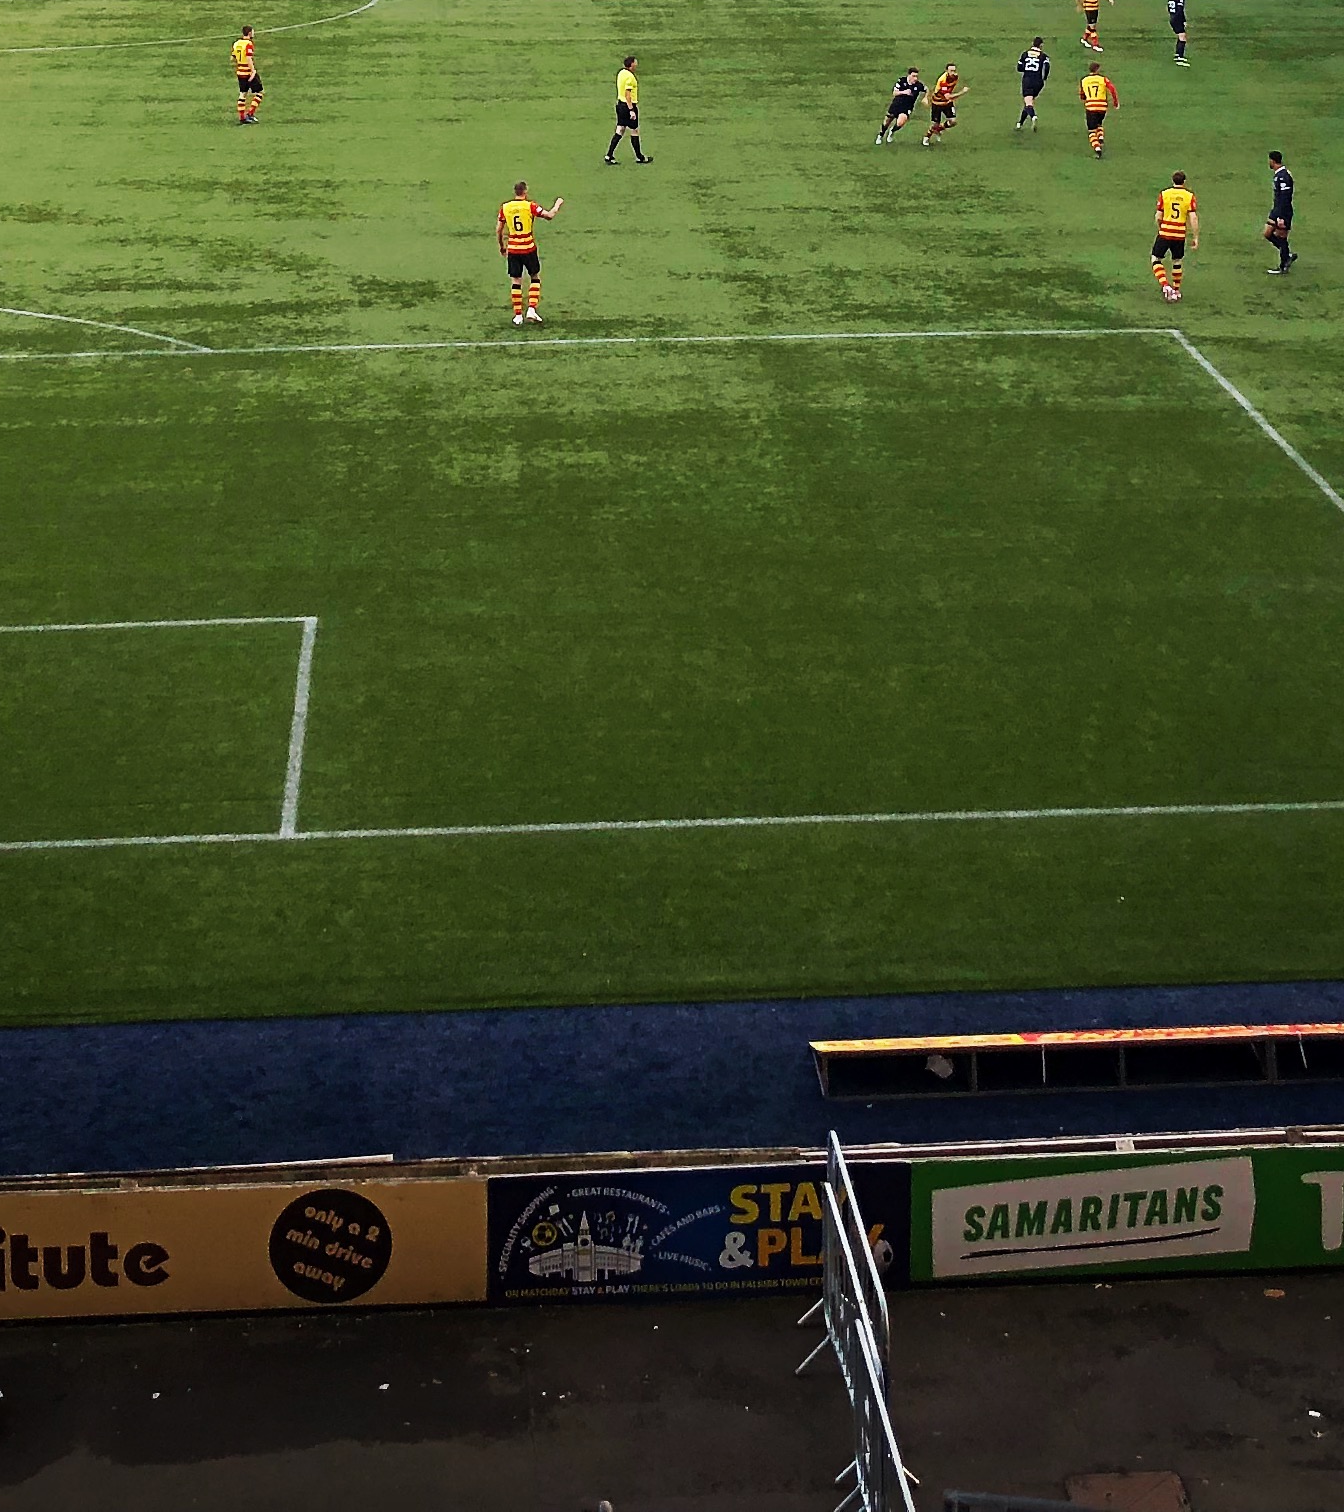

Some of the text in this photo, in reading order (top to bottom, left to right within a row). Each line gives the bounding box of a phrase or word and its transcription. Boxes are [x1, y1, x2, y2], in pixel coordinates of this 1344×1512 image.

[1024, 57, 1042, 72] 25
[1087, 85, 1100, 98] 17
[513, 215, 524, 232] 6
[1170, 202, 1181, 219] 5
[517, 1186, 555, 1225] SHOPPING
[572, 1187, 669, 1215] GREAT RESTAURANTS
[962, 1183, 1226, 1244] SAMARITANS
[304, 1206, 380, 1242] only a 2
[676, 1212, 695, 1228] AND
[696, 1204, 721, 1220] BARS
[285, 1229, 374, 1269] min drive
[658, 1250, 710, 1272] LIVE MUSIC
[718, 1231, 755, 1269] &
[293, 1261, 346, 1292] away
[520, 1287, 569, 1298] MATCHDAY
[571, 1286, 596, 1296] STAY
[605, 1285, 630, 1295] PLAY
